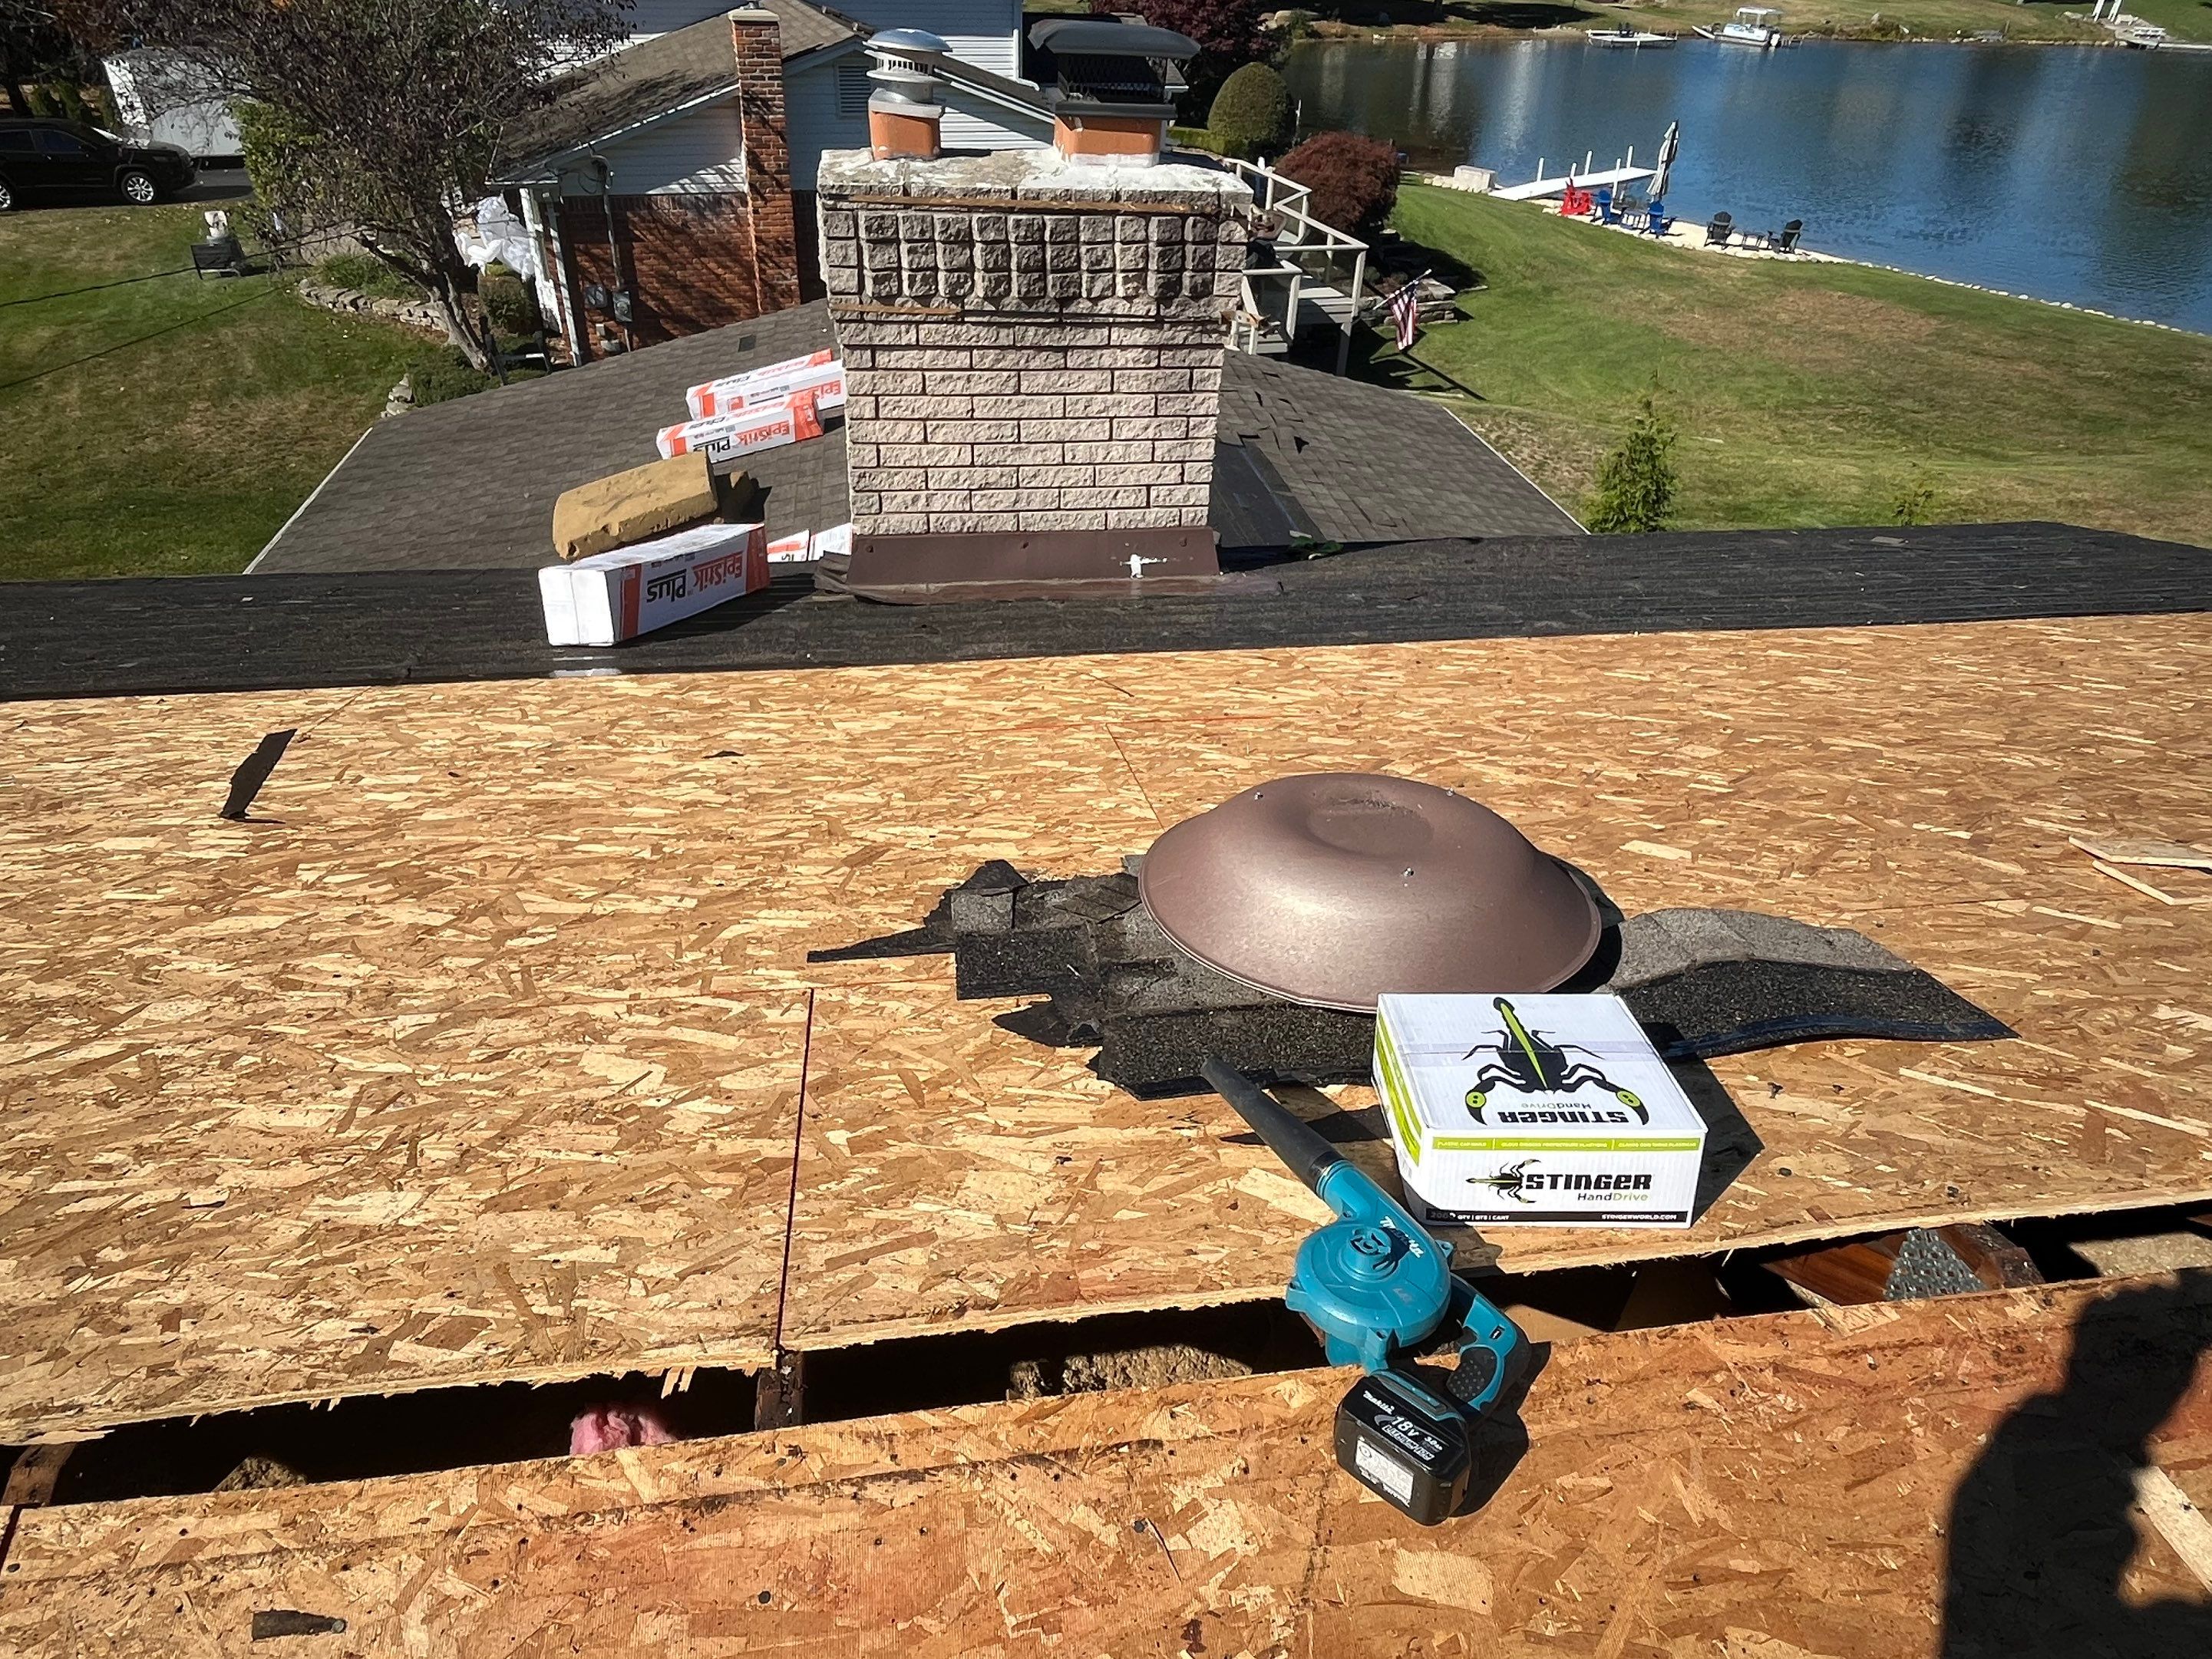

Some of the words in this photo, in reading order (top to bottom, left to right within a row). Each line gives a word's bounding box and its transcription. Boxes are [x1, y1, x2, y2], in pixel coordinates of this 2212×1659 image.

[693, 554, 744, 592] EpiStik
[646, 574, 687, 603] Plus
[1525, 1174, 1652, 1190] STINGER
[1577, 1192, 1649, 1202] HandDrive
